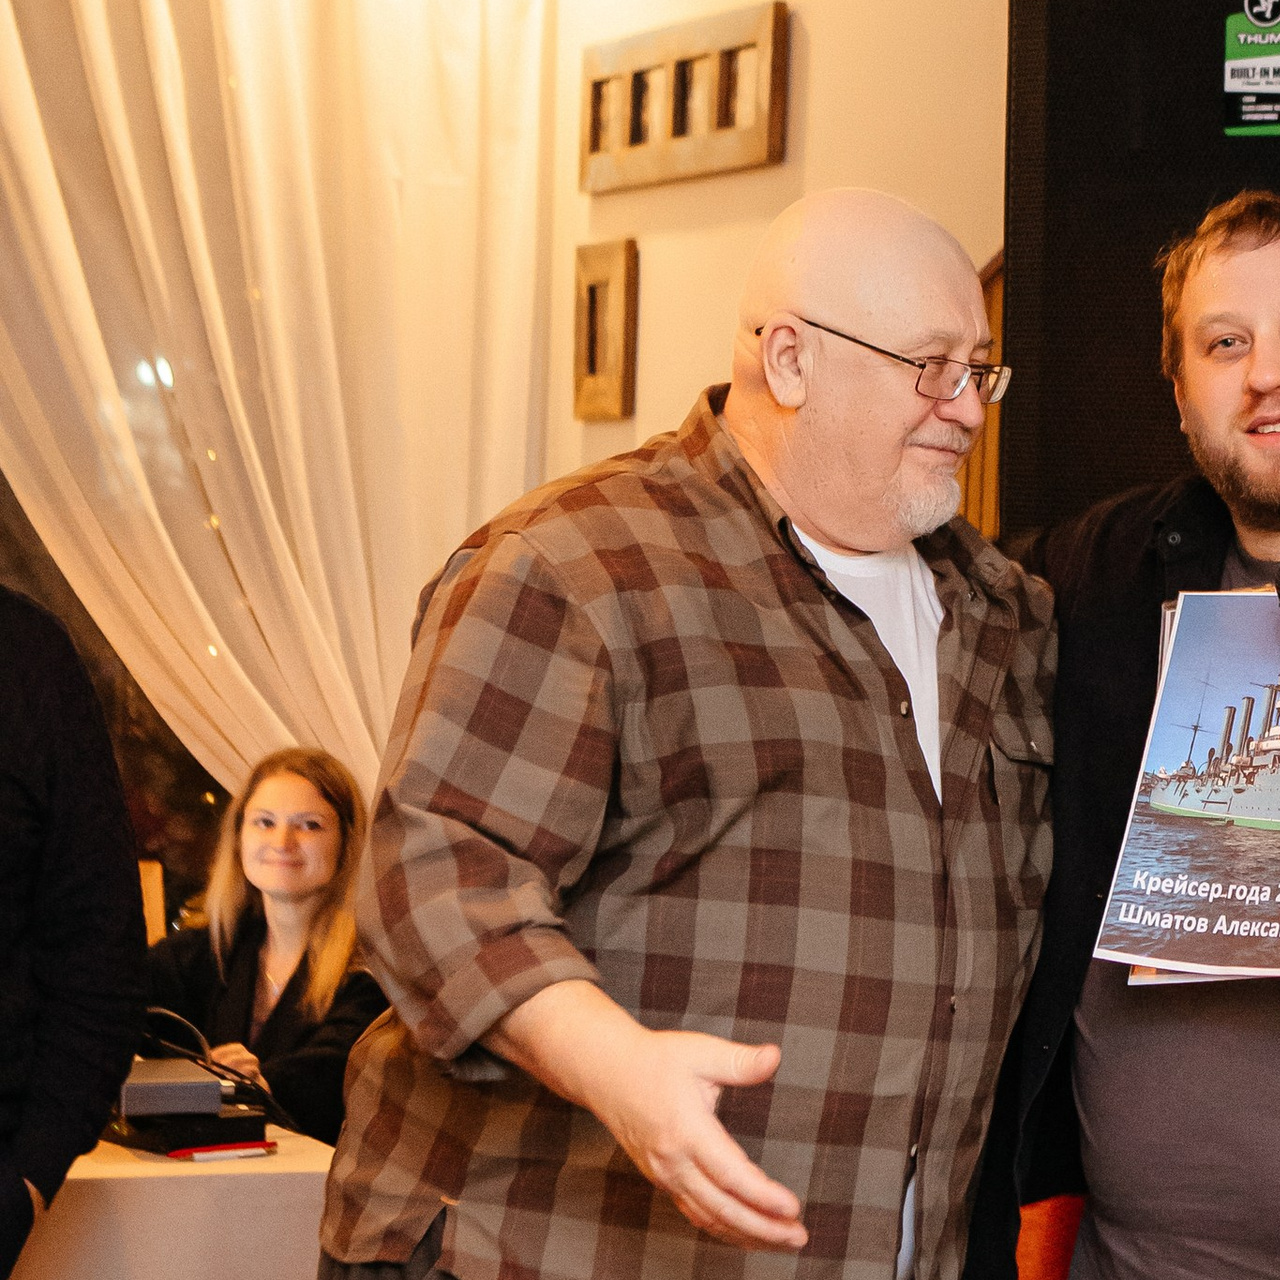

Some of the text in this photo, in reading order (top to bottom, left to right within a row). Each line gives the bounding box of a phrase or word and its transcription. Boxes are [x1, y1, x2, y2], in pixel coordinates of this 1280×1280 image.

[1132, 869, 1223, 903] Крейсер
[1226, 884, 1271, 905] года
[1118, 901, 1209, 933] Шматов
